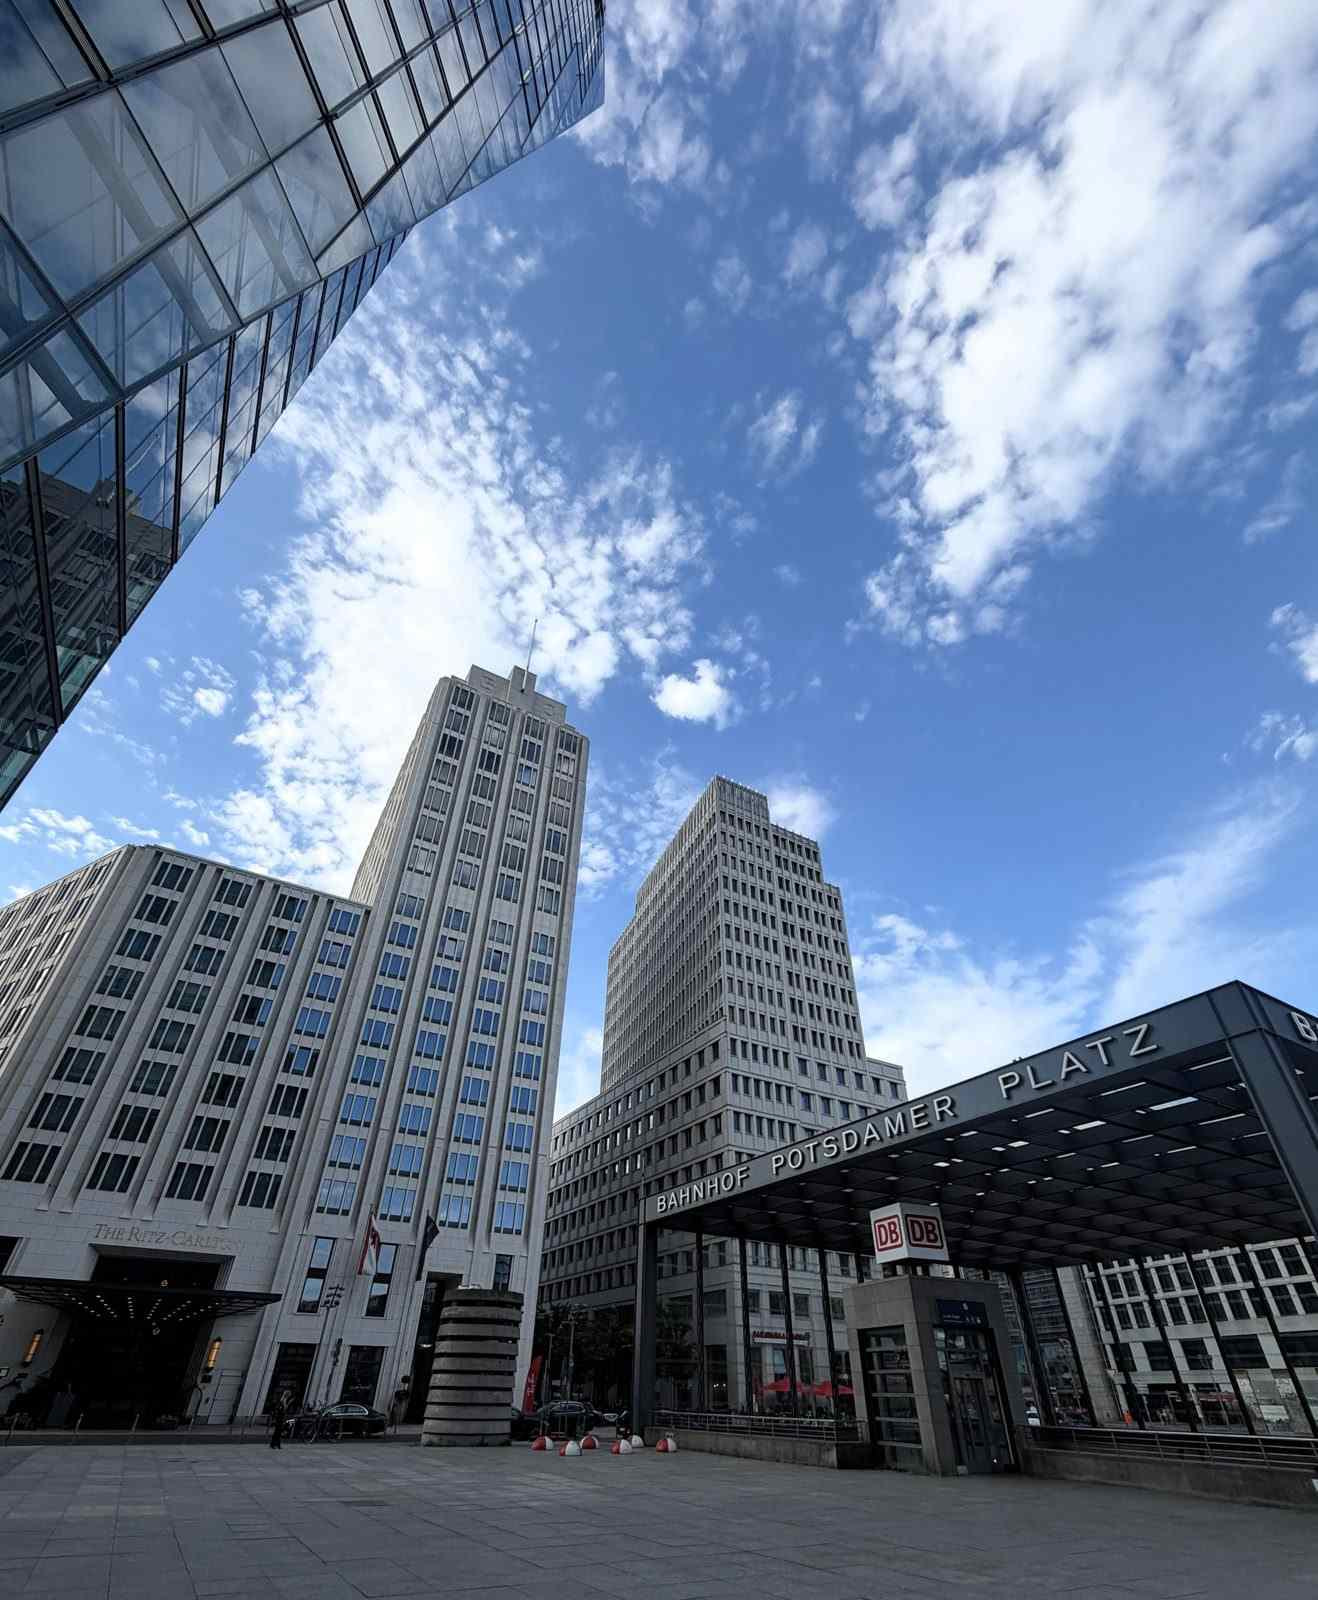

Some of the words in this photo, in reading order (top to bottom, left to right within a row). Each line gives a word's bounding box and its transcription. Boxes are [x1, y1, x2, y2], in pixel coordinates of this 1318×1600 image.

[656, 1166, 750, 1214] BAHNHOF
[771, 1094, 957, 1175] POTSDAMER
[997, 1023, 1159, 1100] PLATZ
[94, 1223, 124, 1240] THE
[877, 1220, 900, 1247] DB
[910, 1219, 939, 1244] DB
